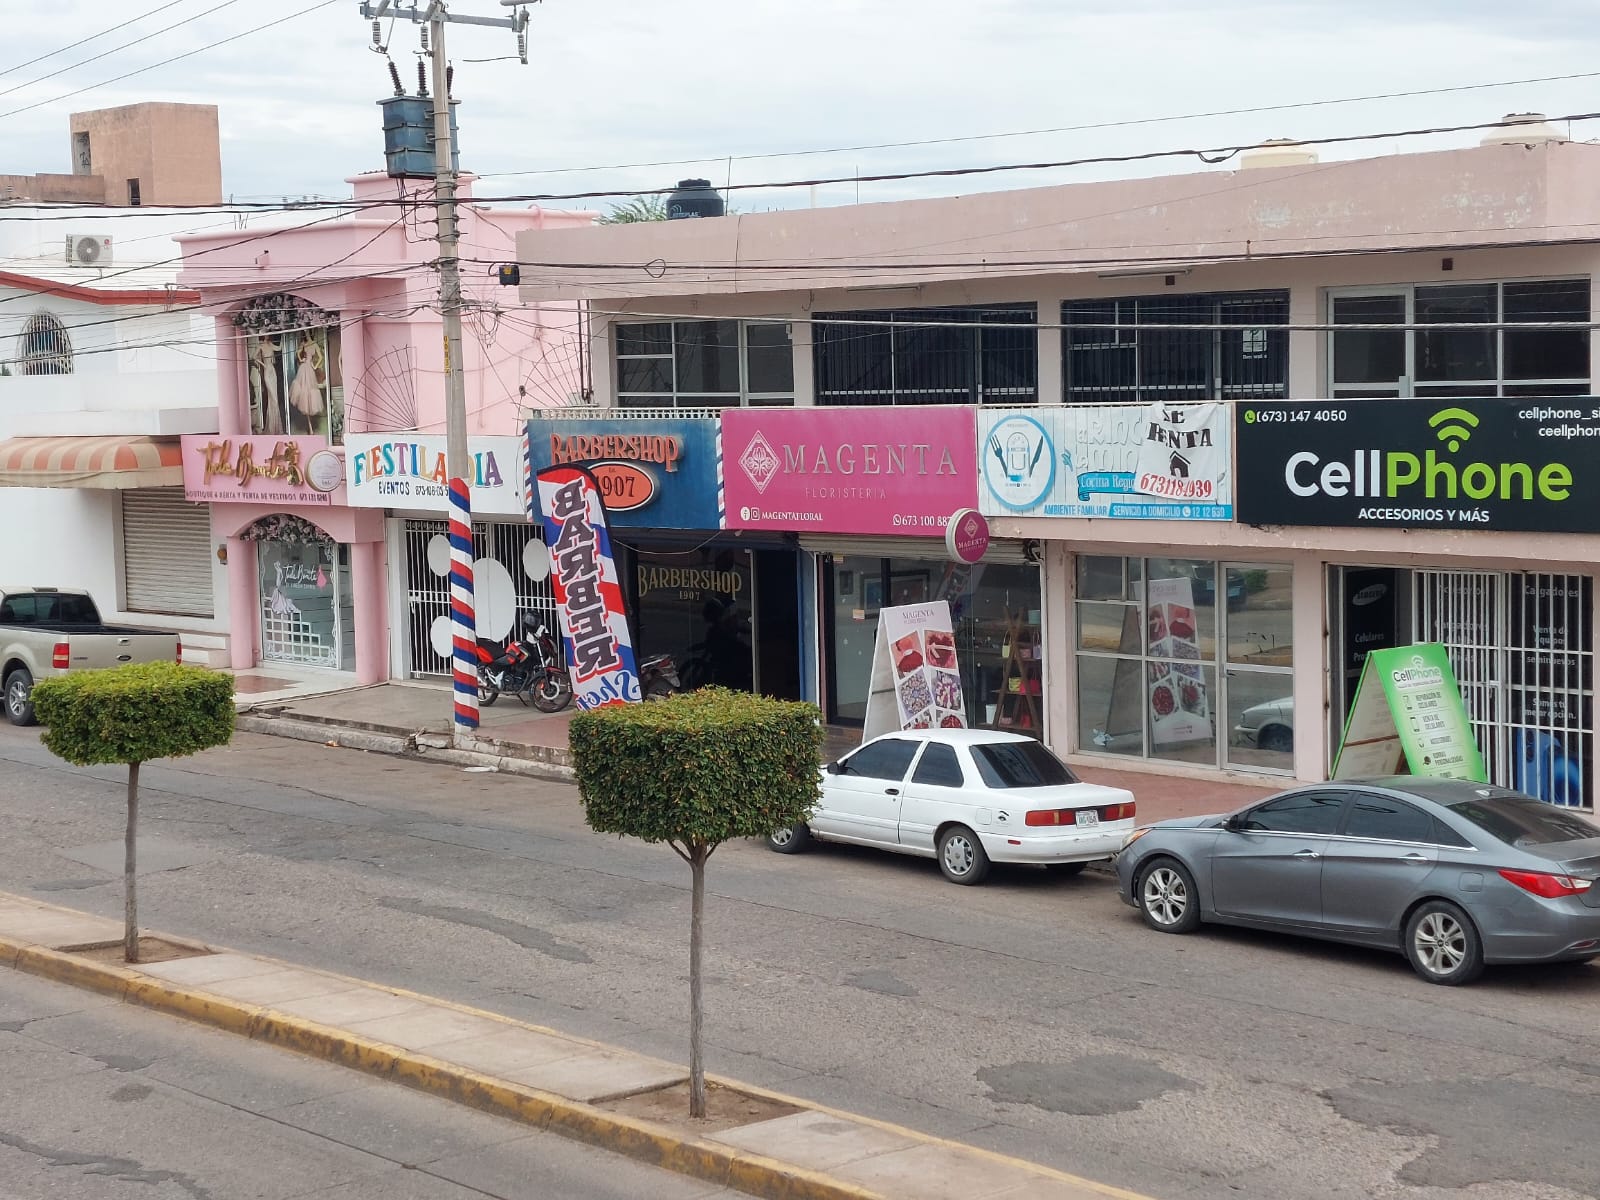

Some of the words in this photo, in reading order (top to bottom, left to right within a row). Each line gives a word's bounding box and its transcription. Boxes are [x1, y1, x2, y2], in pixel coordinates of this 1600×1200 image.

[1256, 409, 1287, 423] (673)
[1290, 410, 1311, 422] 147
[1313, 410, 1348, 422] 4050
[551, 433, 680, 473] BARBERSHOP
[783, 444, 958, 476] MAGENTA
[354, 442, 504, 488] FIESTILADIA
[1284, 449, 1574, 502] CellPhone
[378, 481, 410, 497] EVENTOS
[804, 486, 888, 500] FLORISTERIA
[761, 511, 824, 522] MAGENTAFLORAL
[1043, 503, 1076, 515] AMBIENTE
[1077, 504, 1108, 516] FAMILIAR
[1113, 504, 1141, 517] SERVICIO
[1142, 505, 1148, 517] A
[1148, 505, 1181, 518] DOMICILIO
[1192, 506, 1201, 518] 12
[1202, 506, 1211, 518] 12
[1358, 507, 1444, 522] ACCESORIOS
[1446, 508, 1456, 522] Y
[1459, 506, 1490, 523] MÁS
[901, 514, 918, 527] 673
[920, 515, 936, 527] 100
[958, 537, 987, 549] MAGENTA
[637, 564, 742, 601] BARBERSHOP
[679, 590, 701, 601] 1907
[1525, 584, 1579, 599] Cagadoes
[1393, 665, 1441, 683] CellPhone
